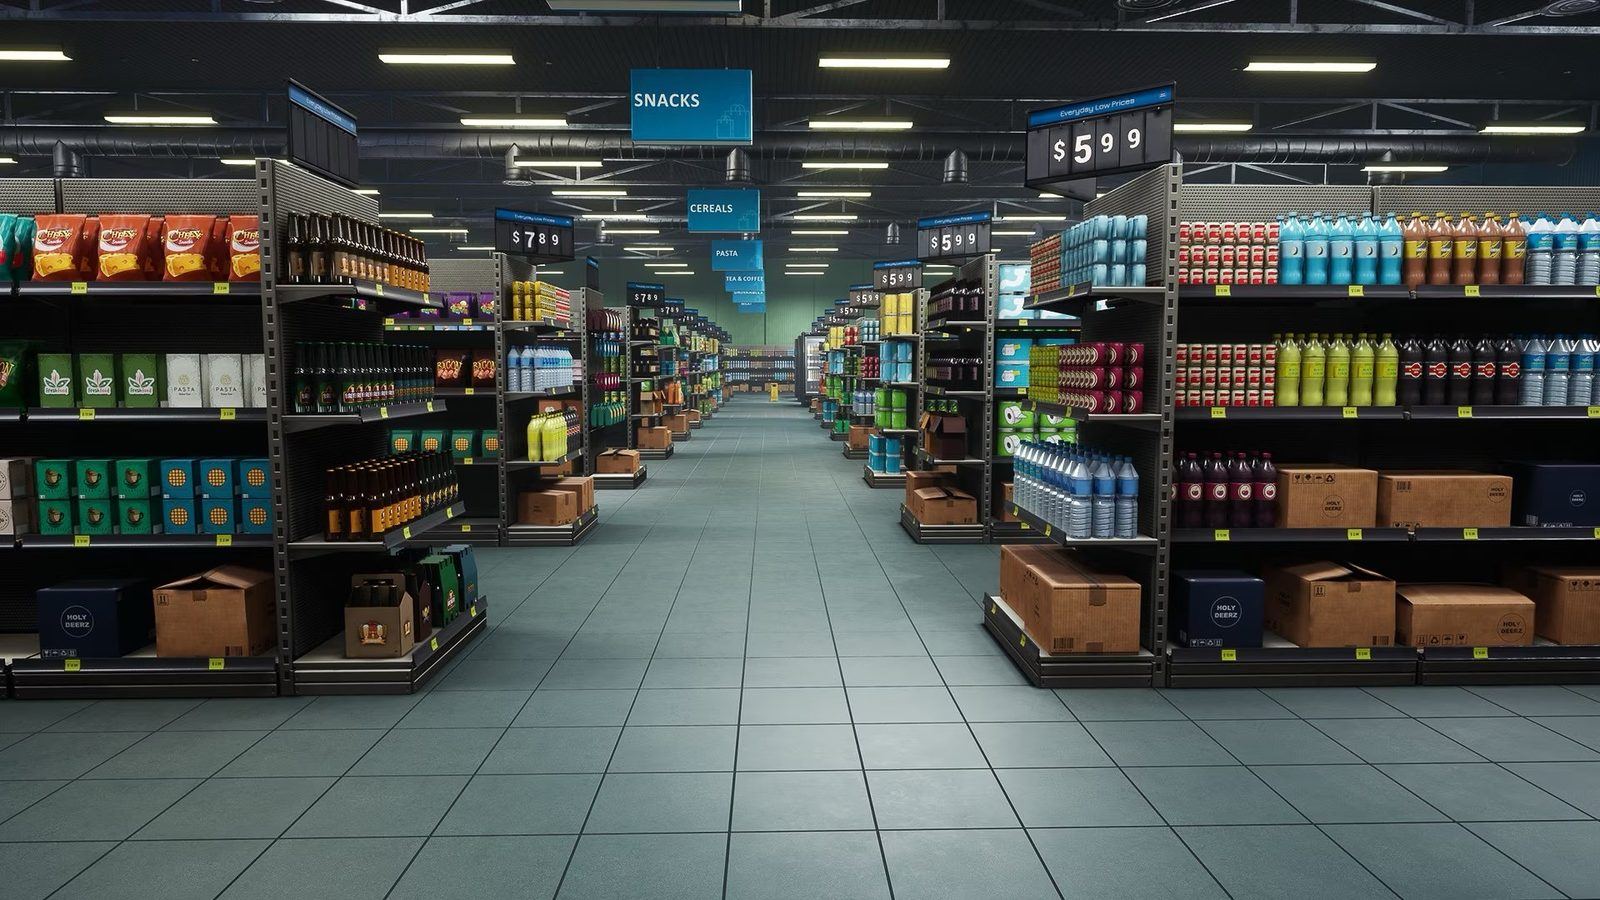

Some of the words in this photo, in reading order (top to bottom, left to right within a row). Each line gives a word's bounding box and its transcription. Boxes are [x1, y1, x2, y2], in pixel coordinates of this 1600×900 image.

[634, 93, 700, 108] SNACKS
[1060, 106, 1094, 117] Everyday
[1095, 103, 1111, 111] Low
[1112, 98, 1135, 107] Prices
[690, 204, 733, 213] CEREALS
